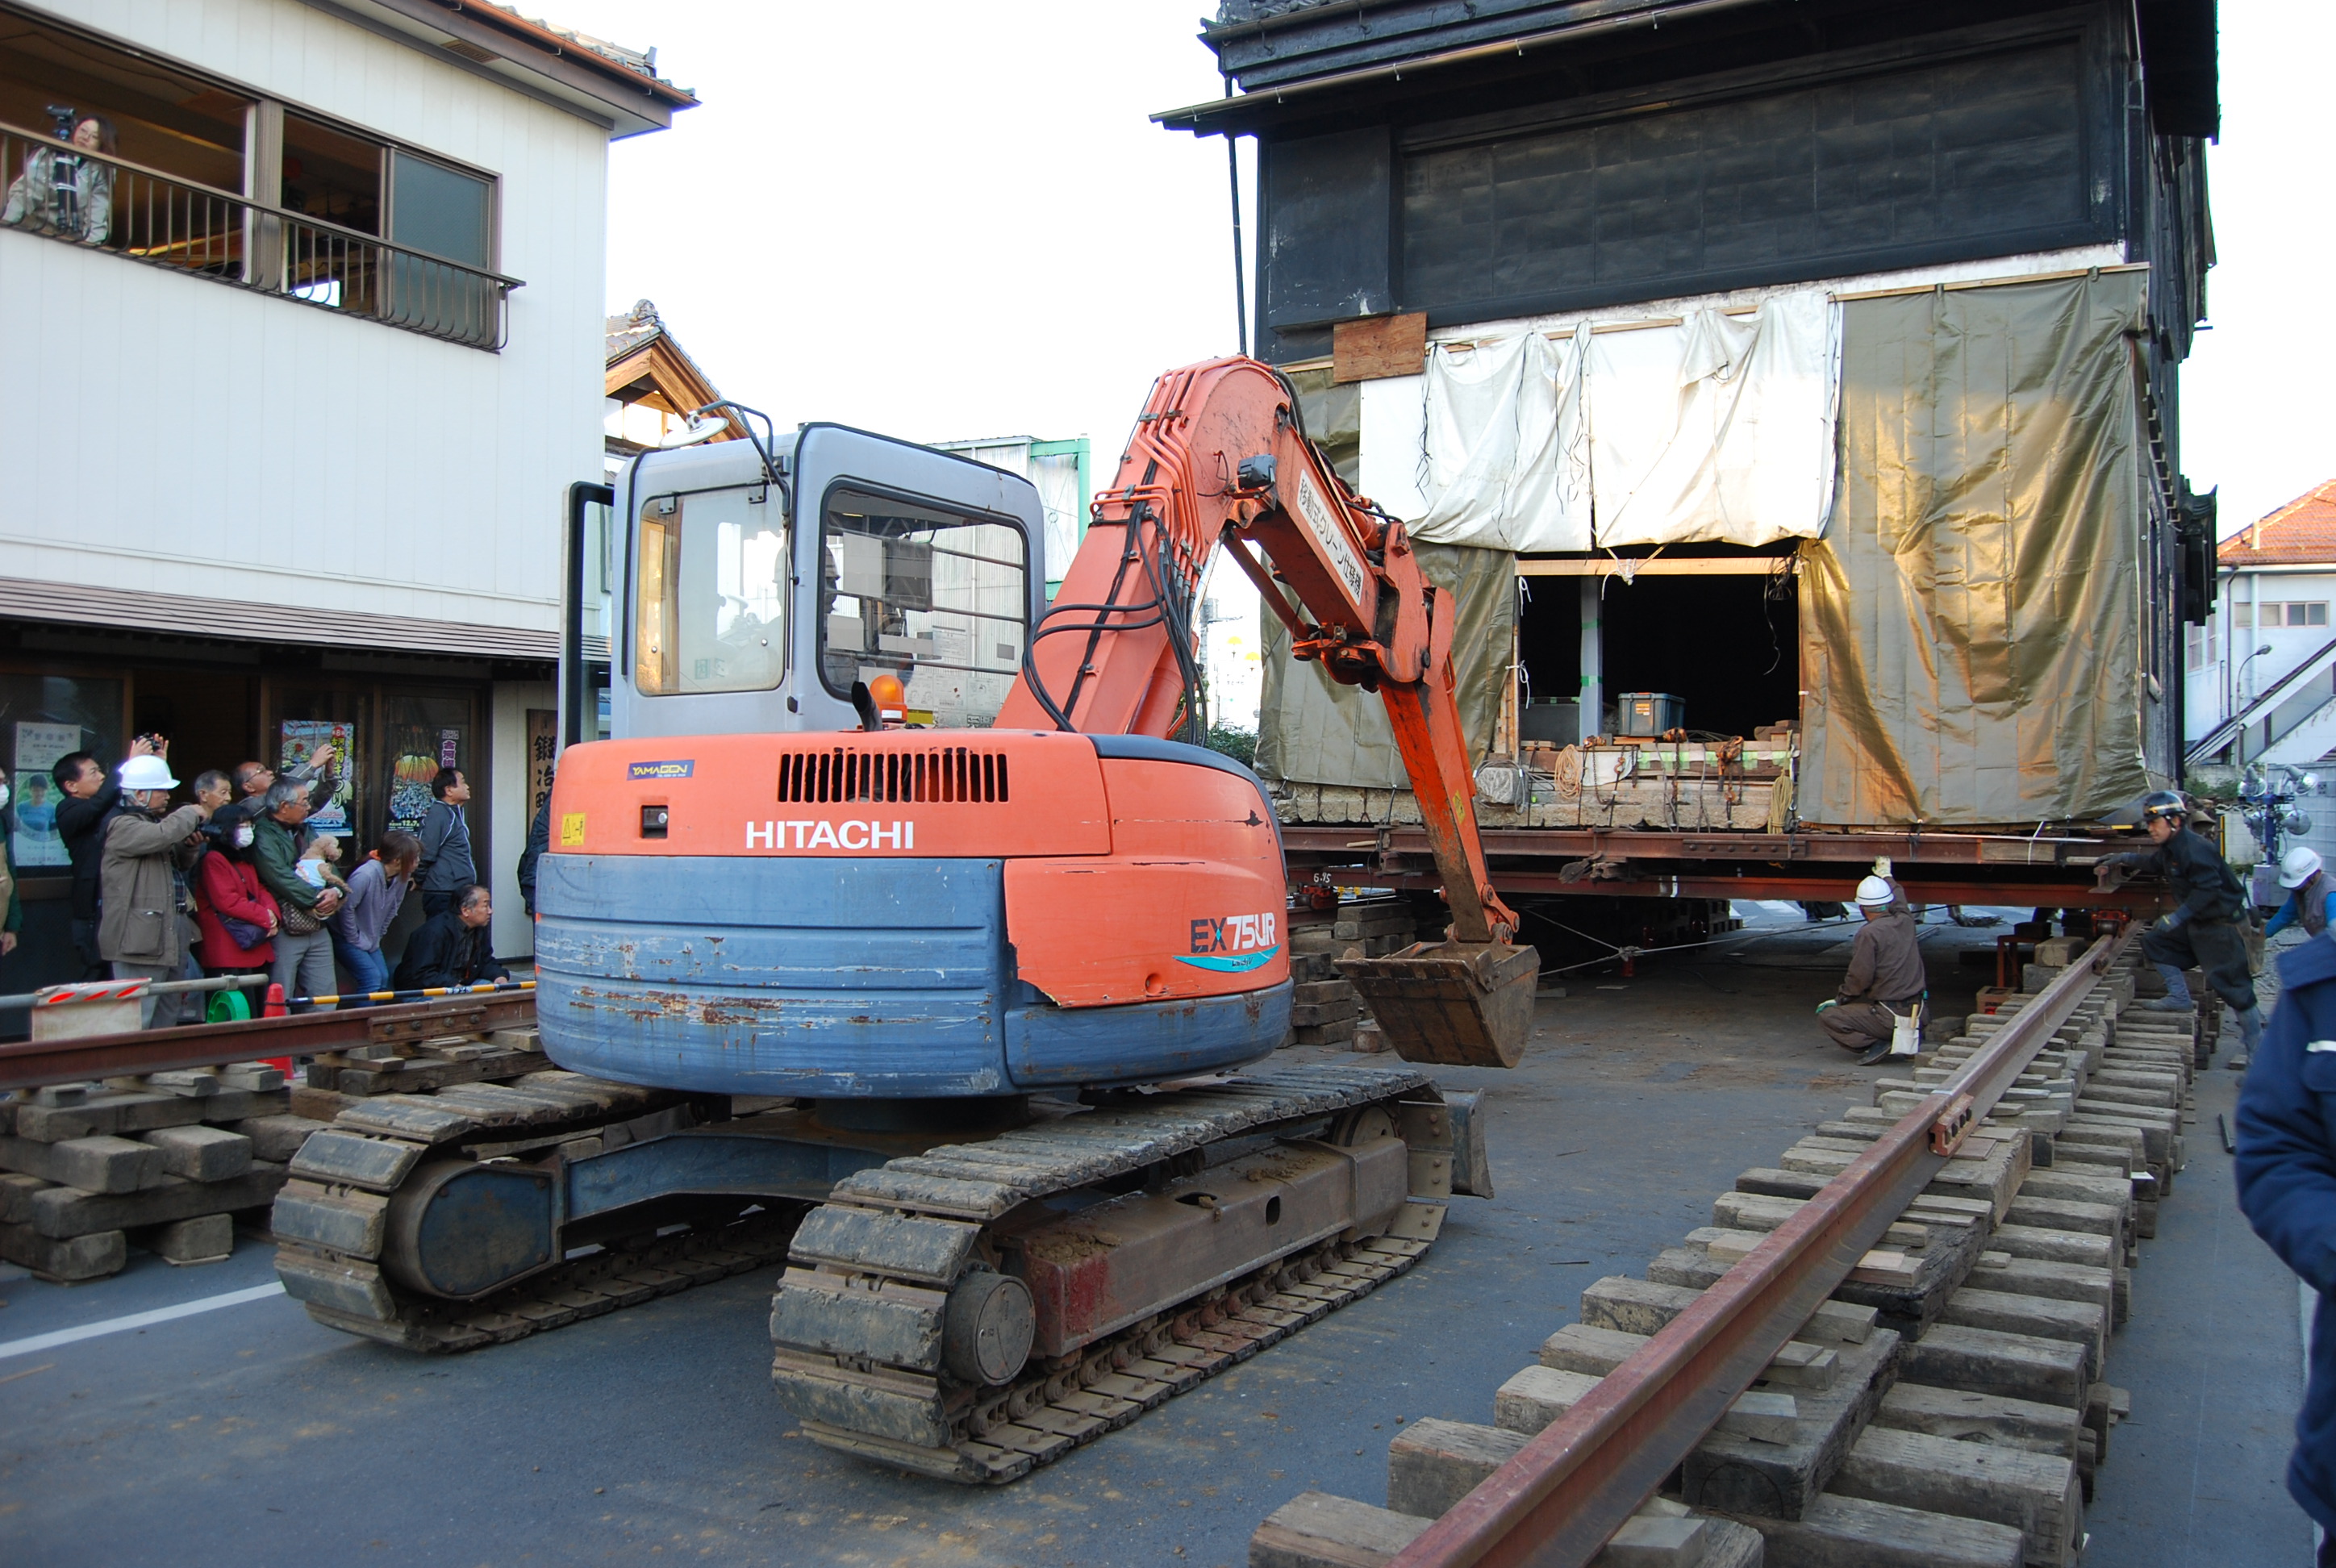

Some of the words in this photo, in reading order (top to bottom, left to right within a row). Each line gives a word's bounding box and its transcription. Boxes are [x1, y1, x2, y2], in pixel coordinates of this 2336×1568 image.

[1299, 477, 1362, 598] 移動式クレーン仕様機
[746, 820, 914, 849] HITACHI
